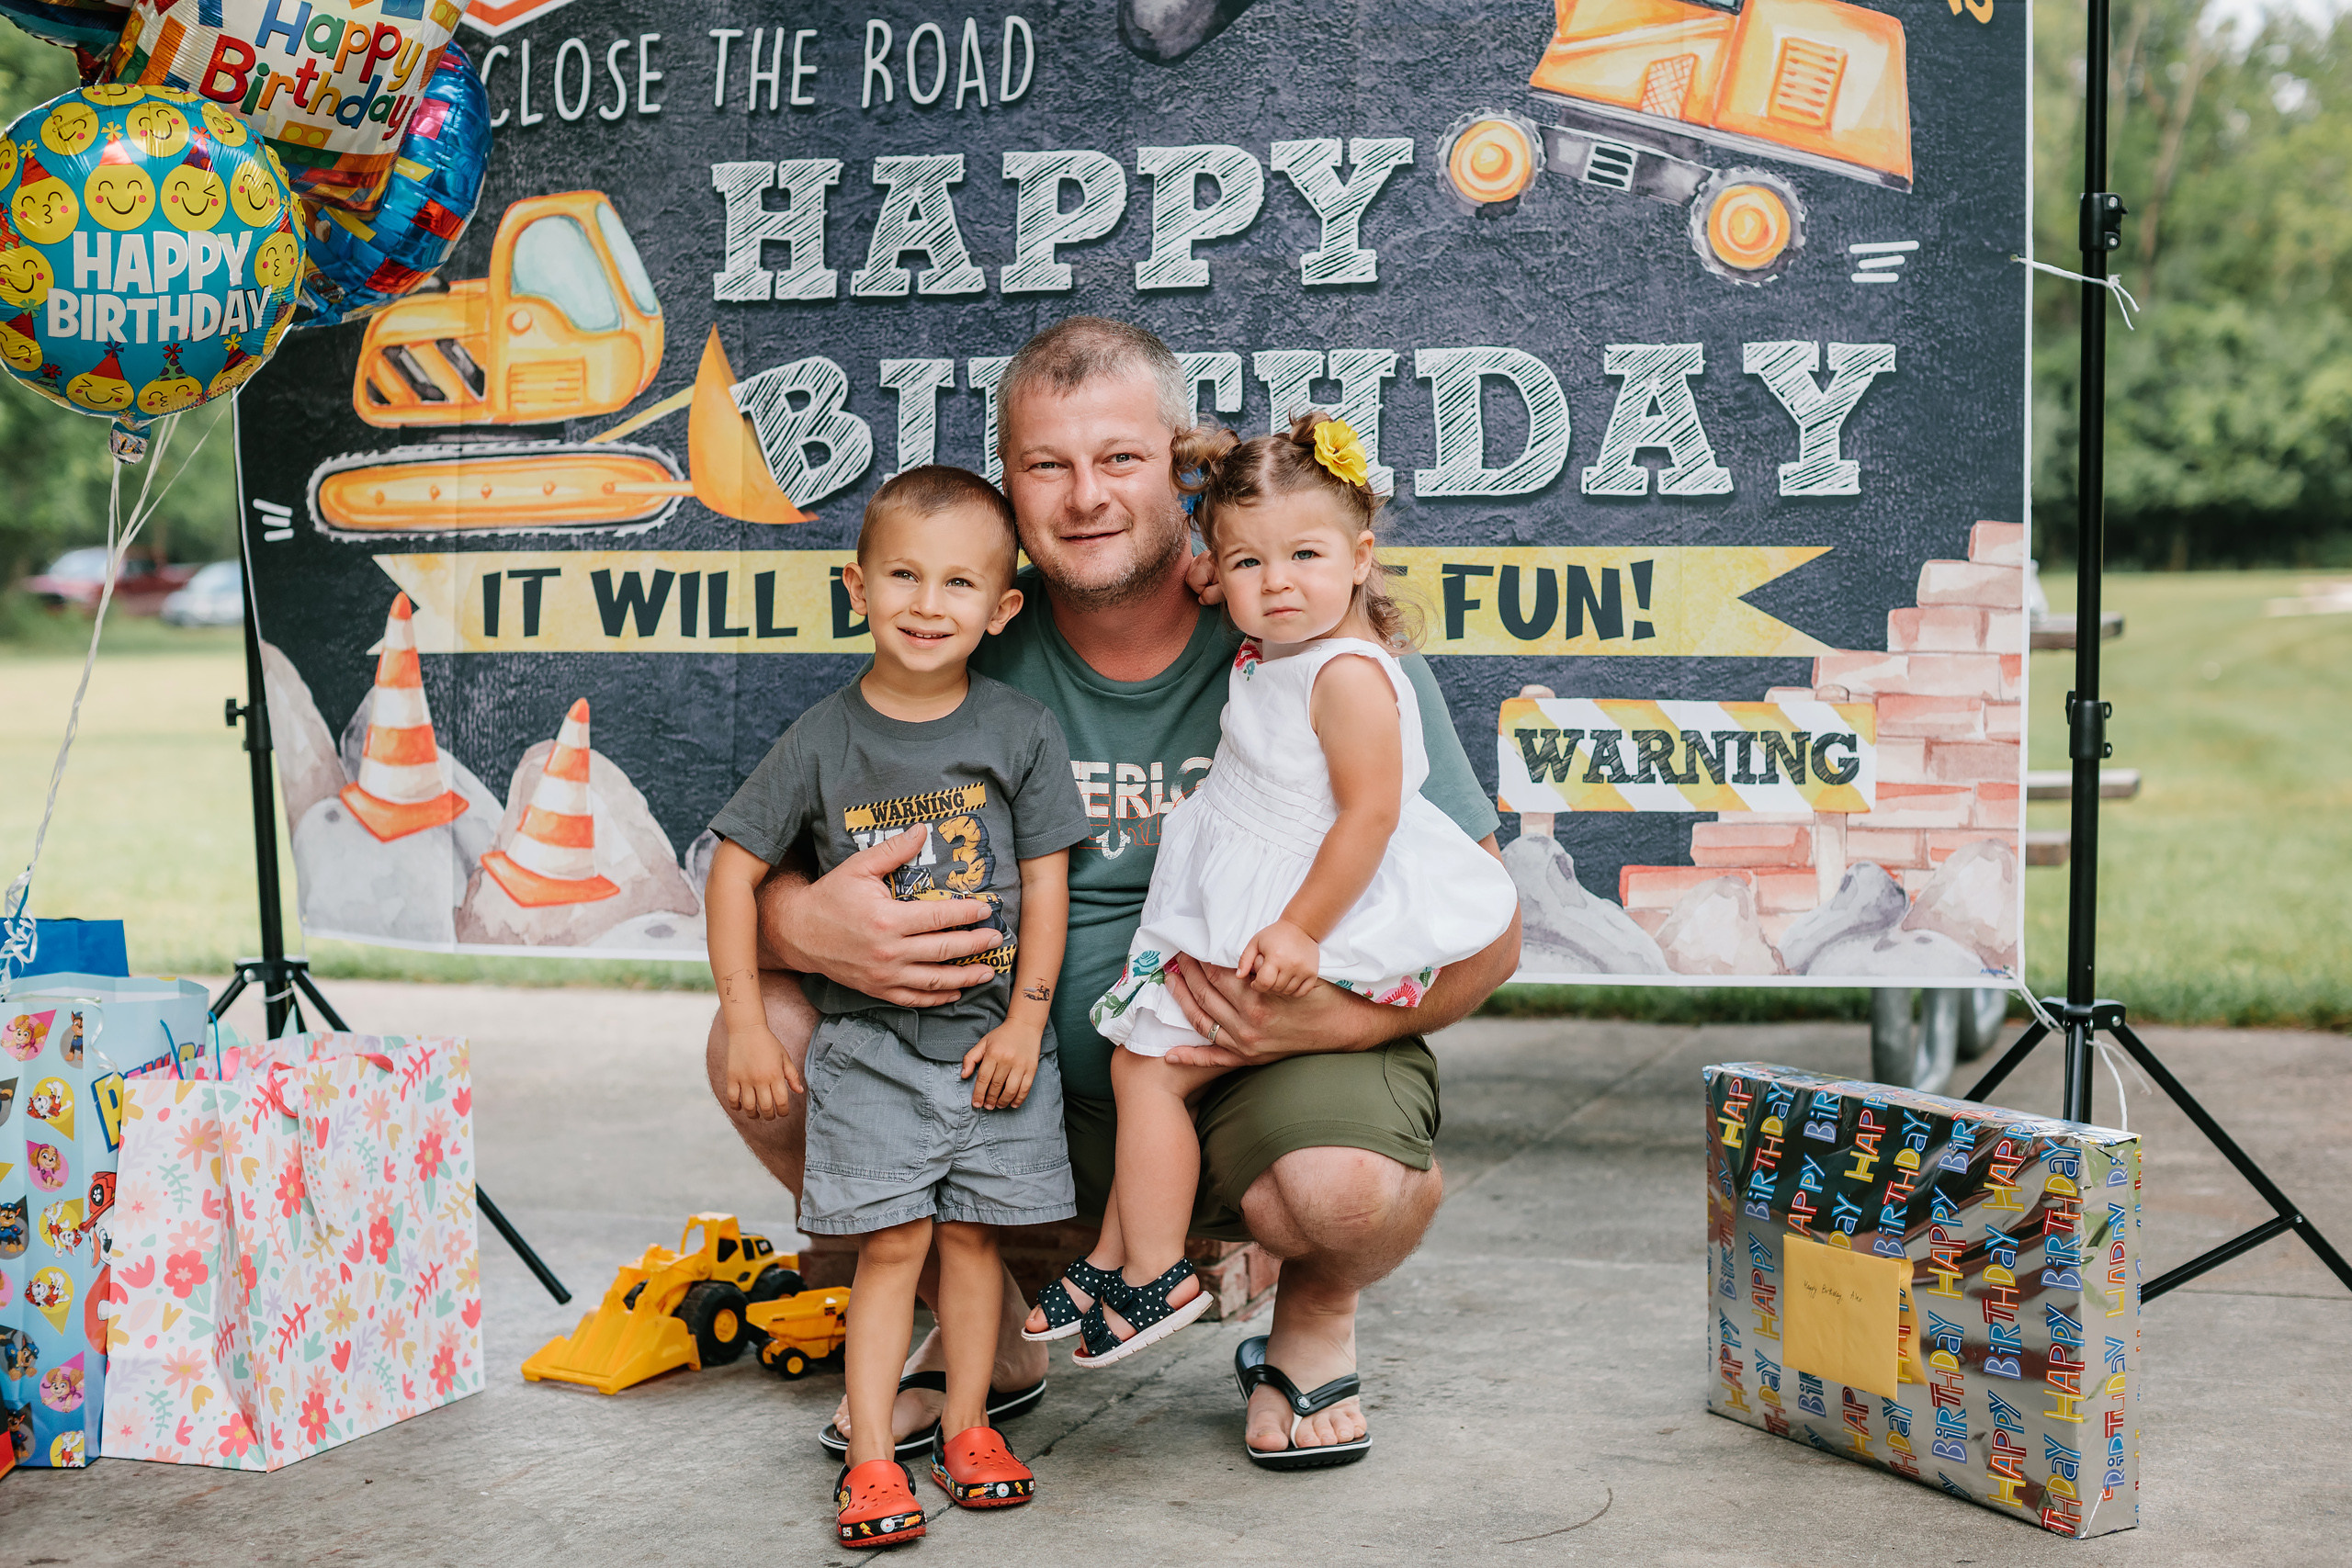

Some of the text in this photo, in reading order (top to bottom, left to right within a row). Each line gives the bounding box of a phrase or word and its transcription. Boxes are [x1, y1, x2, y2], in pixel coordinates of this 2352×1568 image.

[198, 34, 415, 141] Birthday
[254, 0, 425, 93] Happy
[481, 15, 1035, 128] CLOSE THE ROAD
[73, 230, 254, 294] HAPPY
[711, 137, 1416, 302] HAPPY
[47, 284, 274, 344] BIRTHDAY
[482, 568, 561, 638] IT
[590, 568, 798, 638] WILL
[1441, 558, 1656, 641] FUN!
[1514, 728, 1860, 785] WARNING
[870, 792, 965, 824] WARNING
[1748, 1231, 1781, 1341] HAPPY
[1926, 1184, 1967, 1301] HAPPY
[2043, 1303, 2086, 1423] HAPPY
[1986, 1389, 2027, 1508] HAPPY
